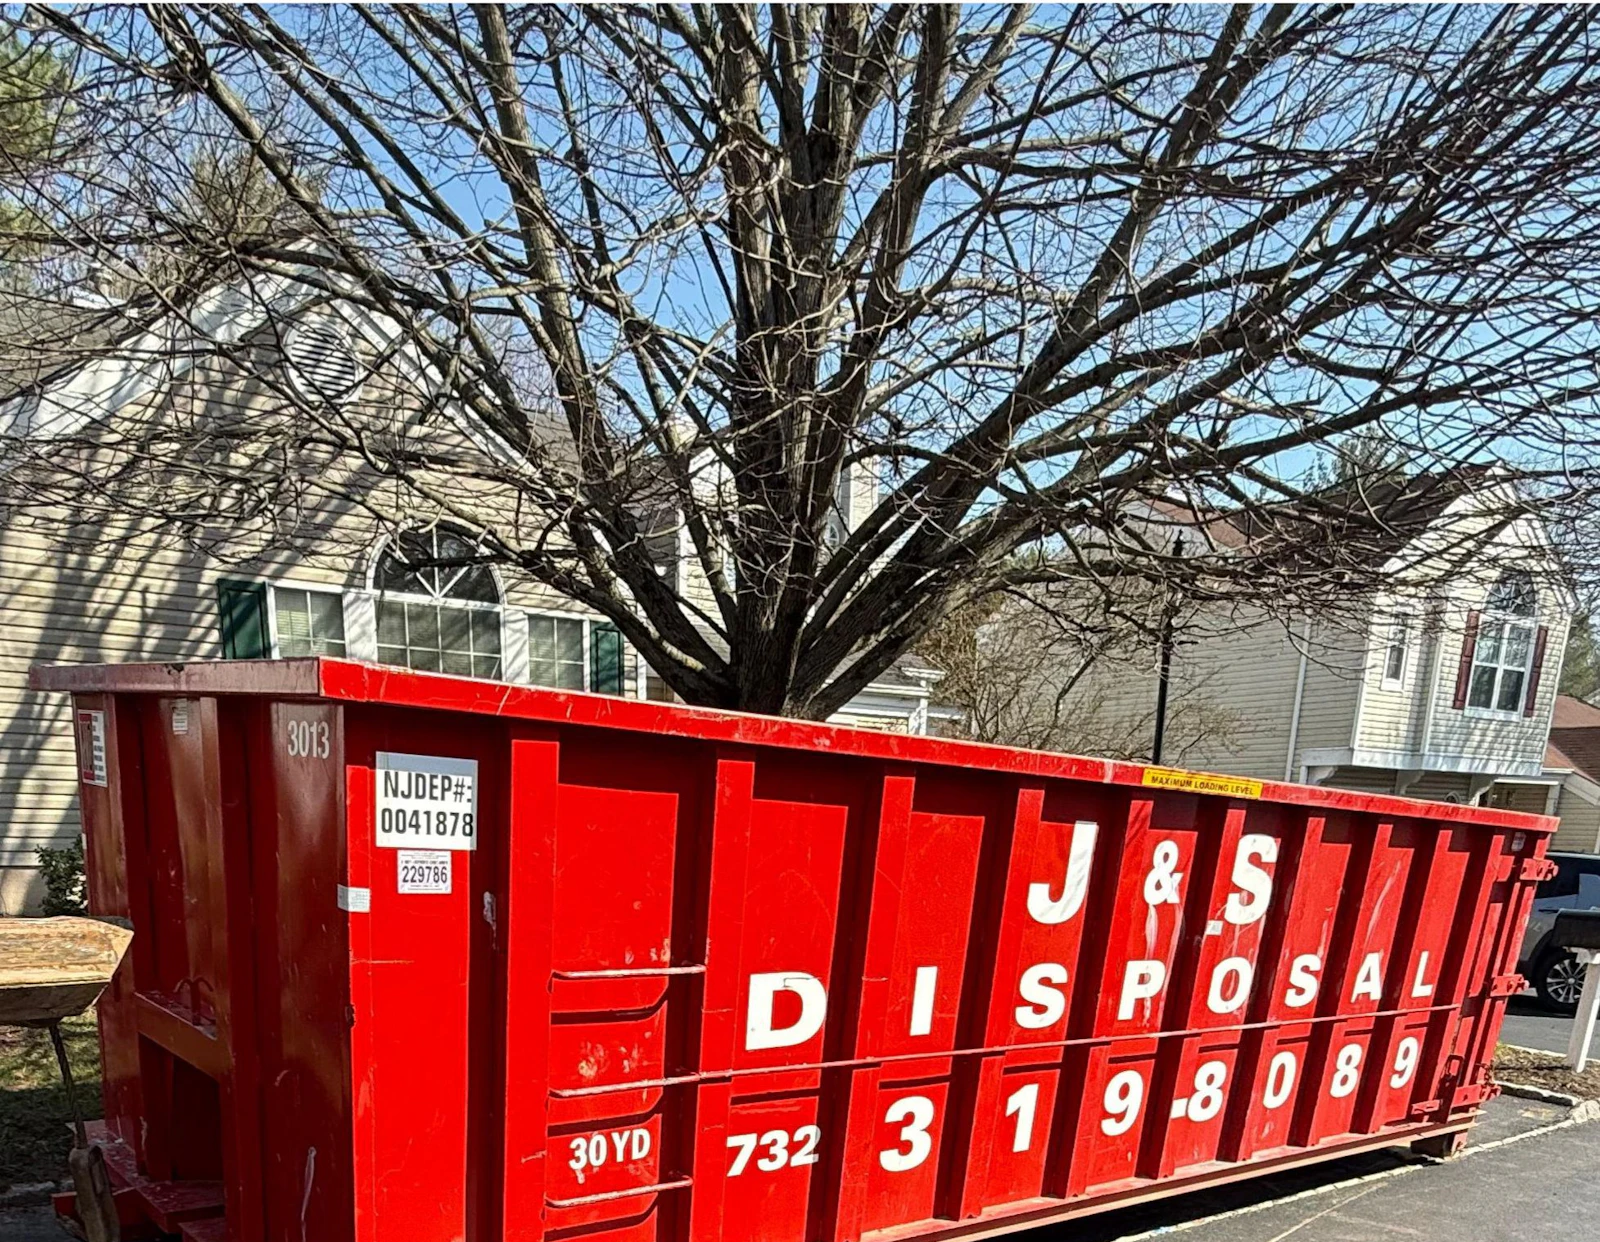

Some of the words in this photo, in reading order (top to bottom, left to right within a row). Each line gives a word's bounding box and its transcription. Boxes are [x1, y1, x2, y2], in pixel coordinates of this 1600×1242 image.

[288, 720, 330, 759] 3013
[1151, 775, 1192, 788] MAXIMUM
[1194, 781, 1229, 793] LOADING
[1231, 784, 1254, 796] LEVEL
[381, 807, 474, 837] 0041878
[402, 865, 448, 884] 229786
[1026, 820, 1098, 924] J
[1143, 839, 1184, 904] &
[1224, 833, 1279, 925] S
[744, 950, 1434, 1051] DISPOSAL
[726, 1124, 821, 1177] 732
